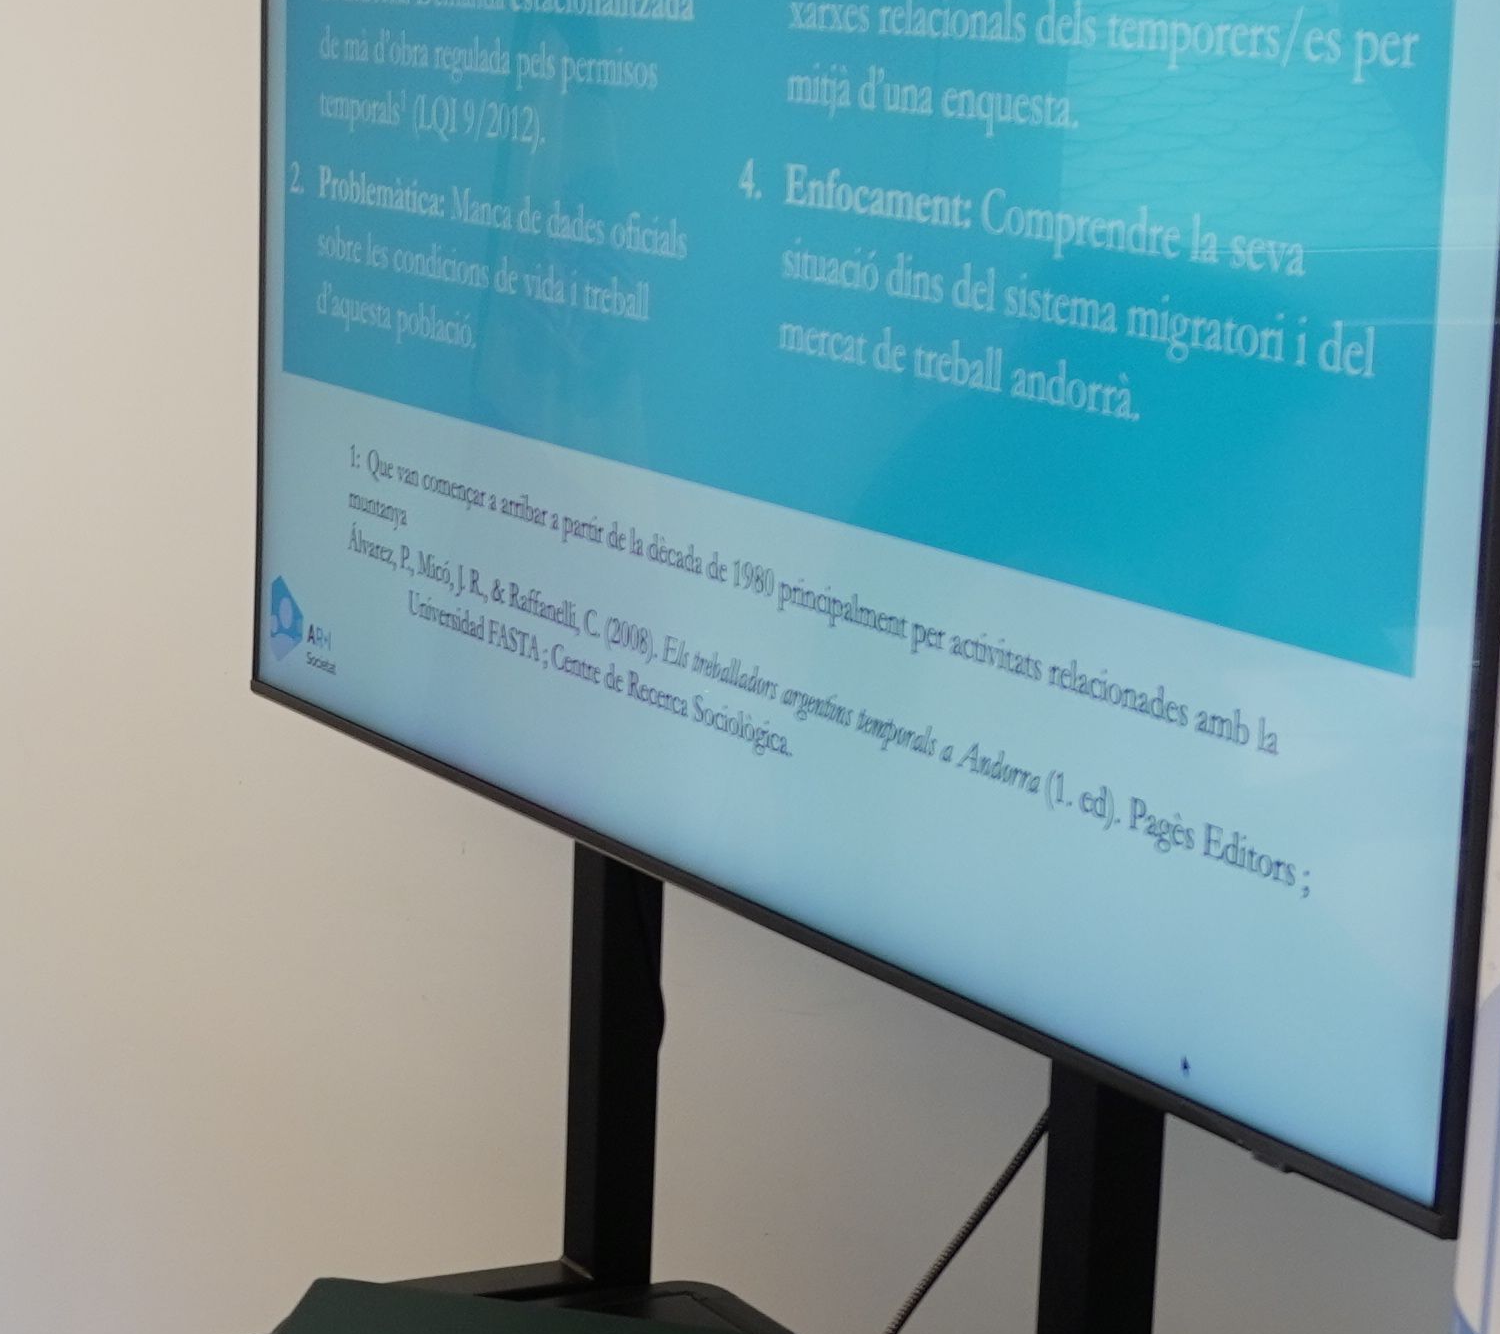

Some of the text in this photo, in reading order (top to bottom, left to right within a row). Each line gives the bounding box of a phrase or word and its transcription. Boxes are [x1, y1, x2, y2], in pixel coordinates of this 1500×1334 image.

[319, 24, 339, 60] de
[373, 26, 429, 66] d'obra
[434, 35, 511, 83] regulada
[516, 40, 556, 91] pels
[560, 46, 659, 94] permisos
[1106, 5, 1342, 71] temporers/es
[1352, 25, 1420, 85] per
[412, 93, 458, 143] (LQI
[463, 96, 546, 154] 9/2012).
[786, 62, 1080, 139] mitjà d'una enquesta.
[290, 161, 688, 260] 2. Problemàtica: Manca de dades oficials
[738, 157, 1306, 277] 4. Enfocament: Comprendre la seva
[316, 282, 392, 333] d'aquesta
[317, 225, 363, 264] sobre
[366, 232, 389, 270] les
[393, 242, 490, 289] condicions
[494, 255, 518, 295] de
[523, 264, 566, 305] vida
[583, 276, 650, 322] treball
[781, 235, 1376, 379] situació dins del sistema migratori i del
[779, 317, 1140, 423] mercat de treball andorrà.
[348, 491, 408, 531] muntanya
[367, 448, 394, 482] Que
[398, 465, 419, 488] van
[422, 473, 487, 511] començar
[501, 493, 548, 527] arribar
[561, 515, 604, 544] partir
[608, 520, 627, 551] de
[630, 526, 644, 556] la
[647, 531, 703, 574] dècada
[706, 550, 728, 582] de
[732, 557, 775, 597] 1980
[777, 577, 908, 640] principalment
[910, 616, 945, 655] per
[948, 630, 1044, 680] activitats
[1048, 662, 1190, 727] relacionades
[1193, 709, 1251, 748] amb
[1257, 716, 1280, 757] la
[408, 589, 485, 641] Universidad
[488, 618, 541, 662] FASTA
[550, 642, 601, 685] Centre
[603, 662, 624, 693] de
[627, 669, 690, 718] Recerca
[490, 578, 505, 603] &
[508, 581, 581, 637] Raffanelli,
[603, 616, 659, 665] (2008).
[662, 634, 690, 668] Els
[692, 652, 779, 700] treballadors
[781, 687, 853, 727] argentins
[856, 708, 940, 758] temporals
[940, 742, 953, 764] a
[957, 740, 1041, 794] Andorra
[1044, 769, 1074, 812] (1.
[1079, 782, 1122, 832] ed).
[1128, 794, 1196, 854] Pagès
[1200, 821, 1298, 887] Editors
